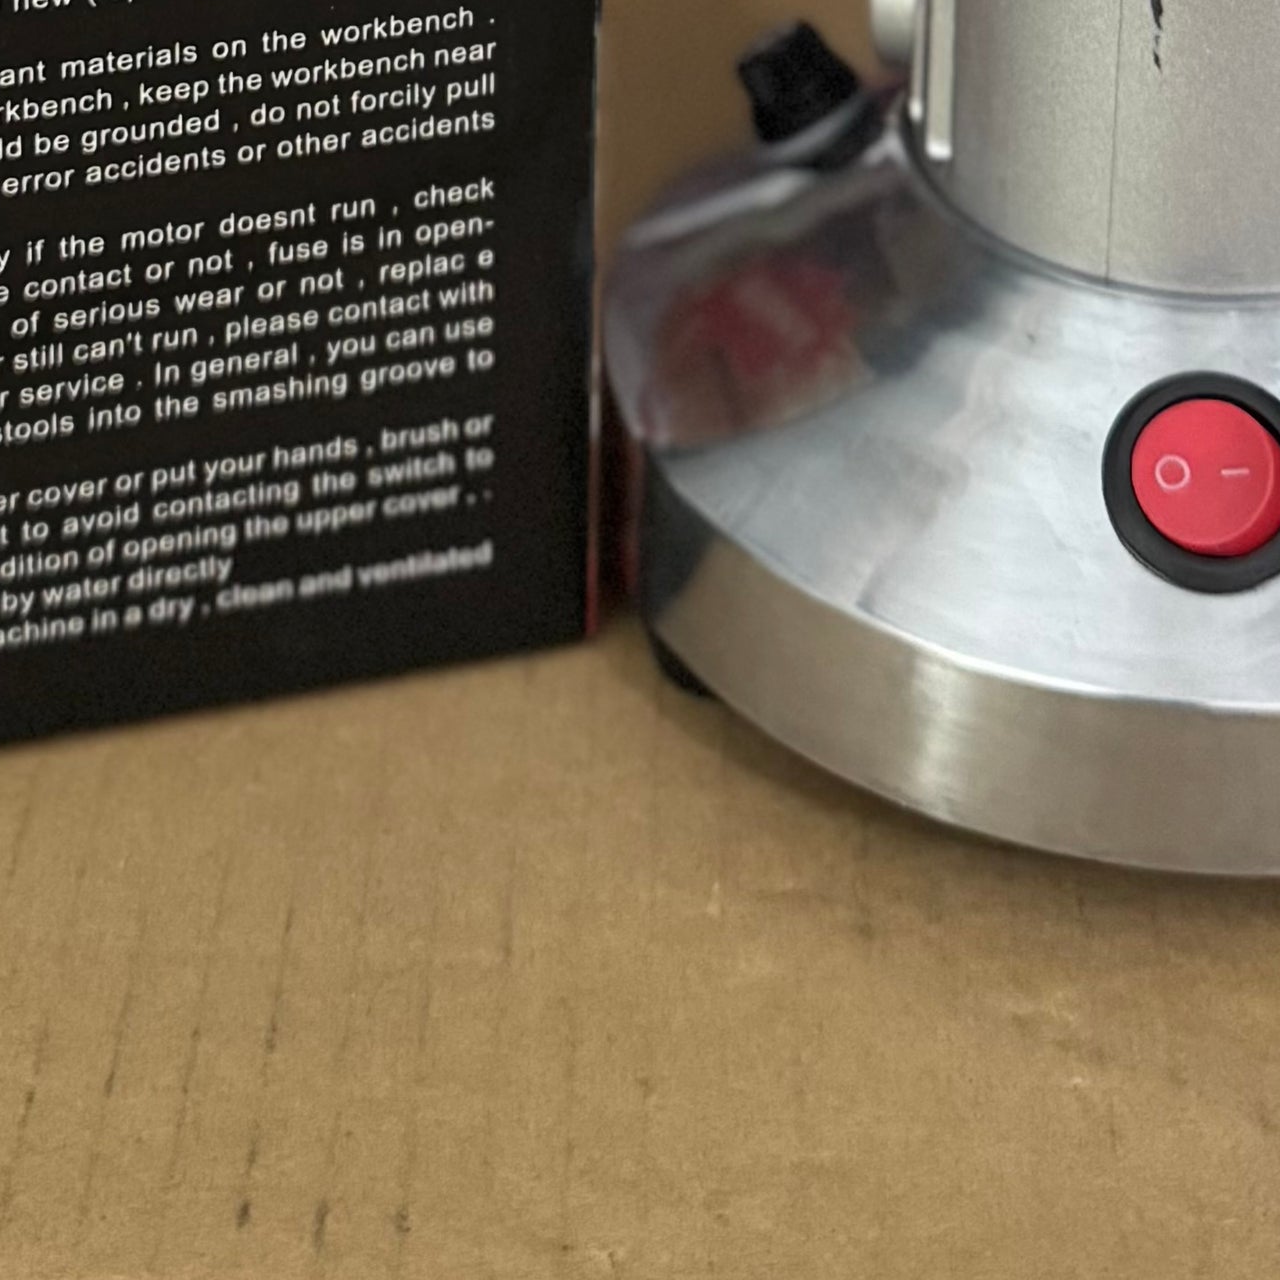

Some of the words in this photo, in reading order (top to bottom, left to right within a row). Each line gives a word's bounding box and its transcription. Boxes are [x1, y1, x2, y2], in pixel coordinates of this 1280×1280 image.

[138, 79, 210, 106] keep
[217, 70, 263, 96] the
[270, 47, 426, 89] workbench
[433, 41, 498, 67] near
[0, 168, 76, 196] error
[84, 146, 227, 185] accidents
[236, 142, 268, 164] or
[276, 131, 352, 159] other
[360, 109, 496, 148] accidents
[88, 402, 142, 431] into
[154, 394, 200, 421] the
[212, 372, 349, 411] smashing
[359, 355, 456, 393] groove
[466, 348, 496, 372] to
[1, 591, 35, 615] by
[42, 576, 121, 606] water
[128, 555, 232, 590] directly
